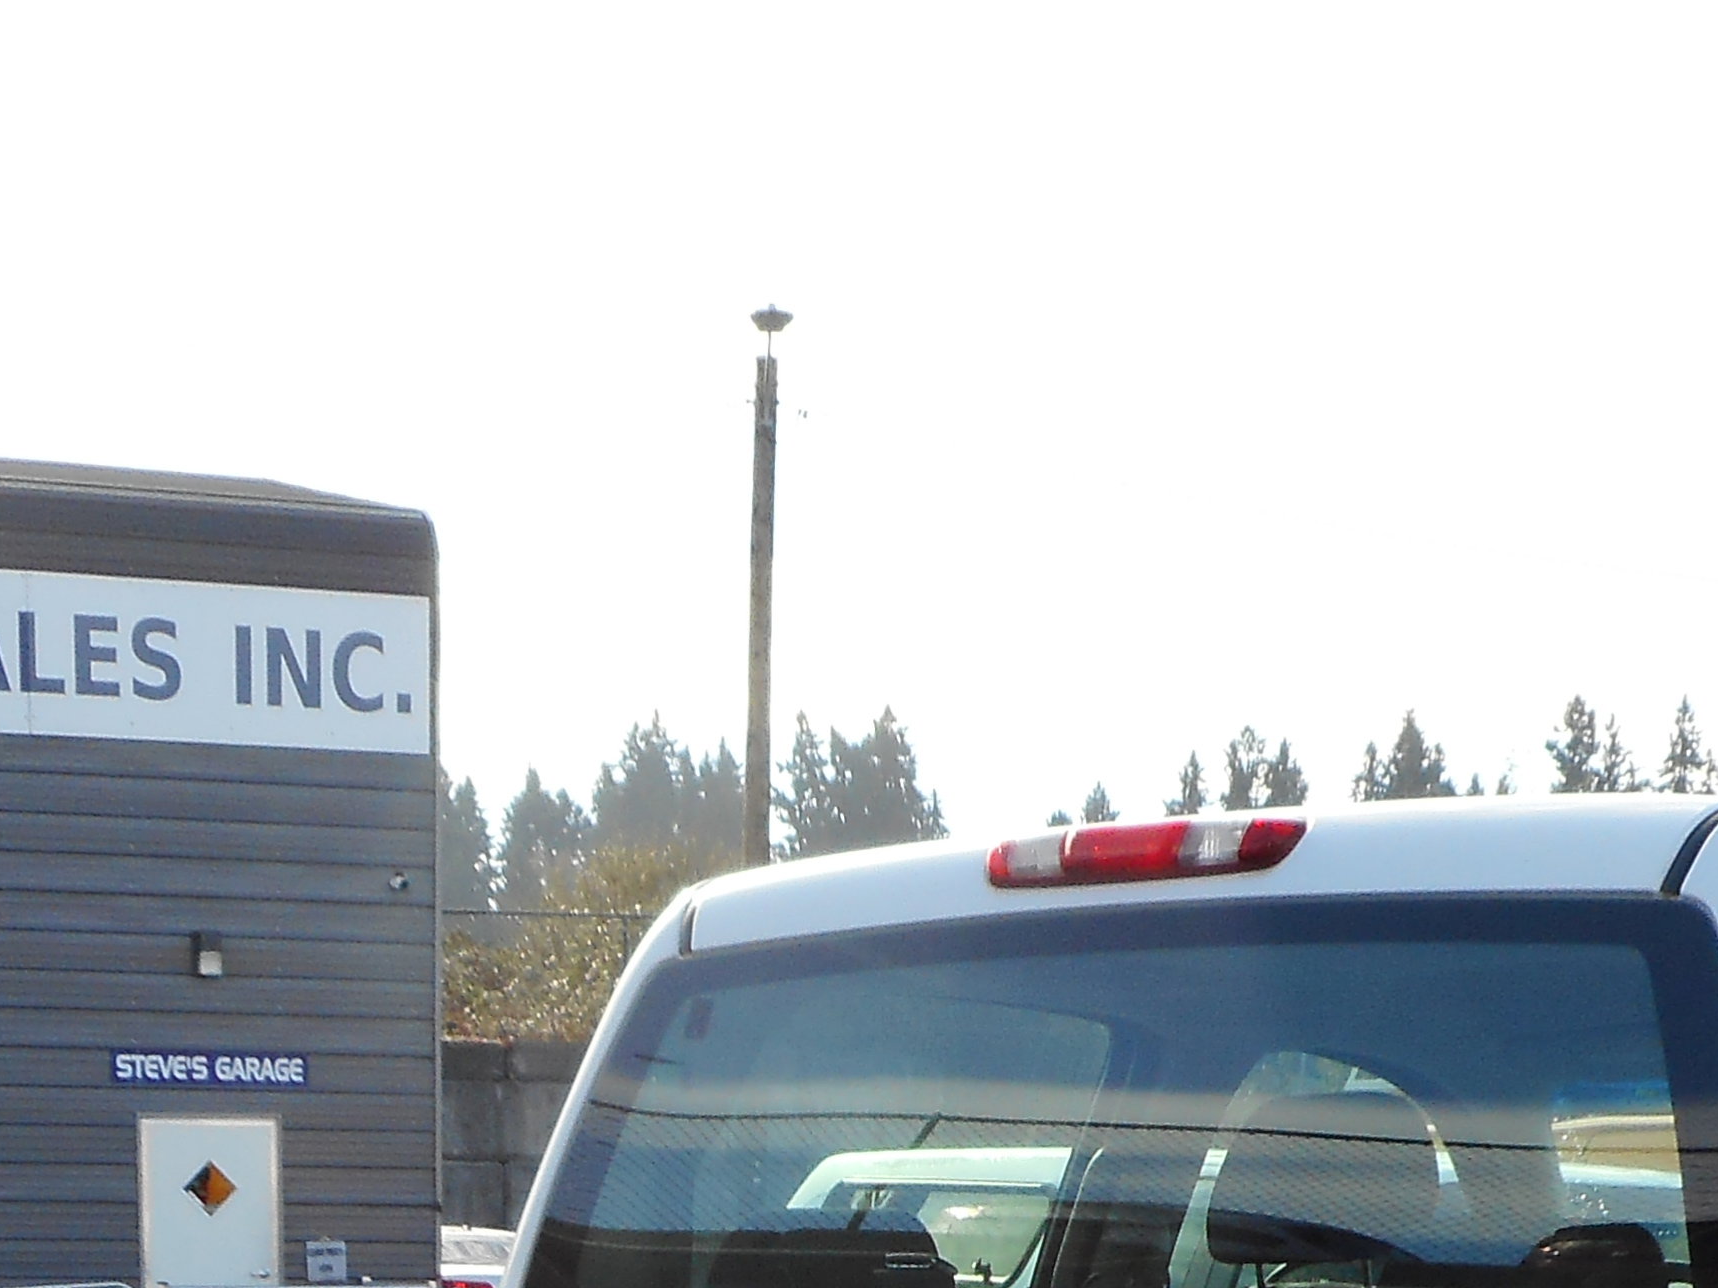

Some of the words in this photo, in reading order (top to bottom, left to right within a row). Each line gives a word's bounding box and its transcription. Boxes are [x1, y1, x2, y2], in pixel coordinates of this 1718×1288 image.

[233, 624, 411, 714] INC.
[115, 1053, 208, 1081] STEVE'S
[214, 1056, 305, 1083] GARAGE
